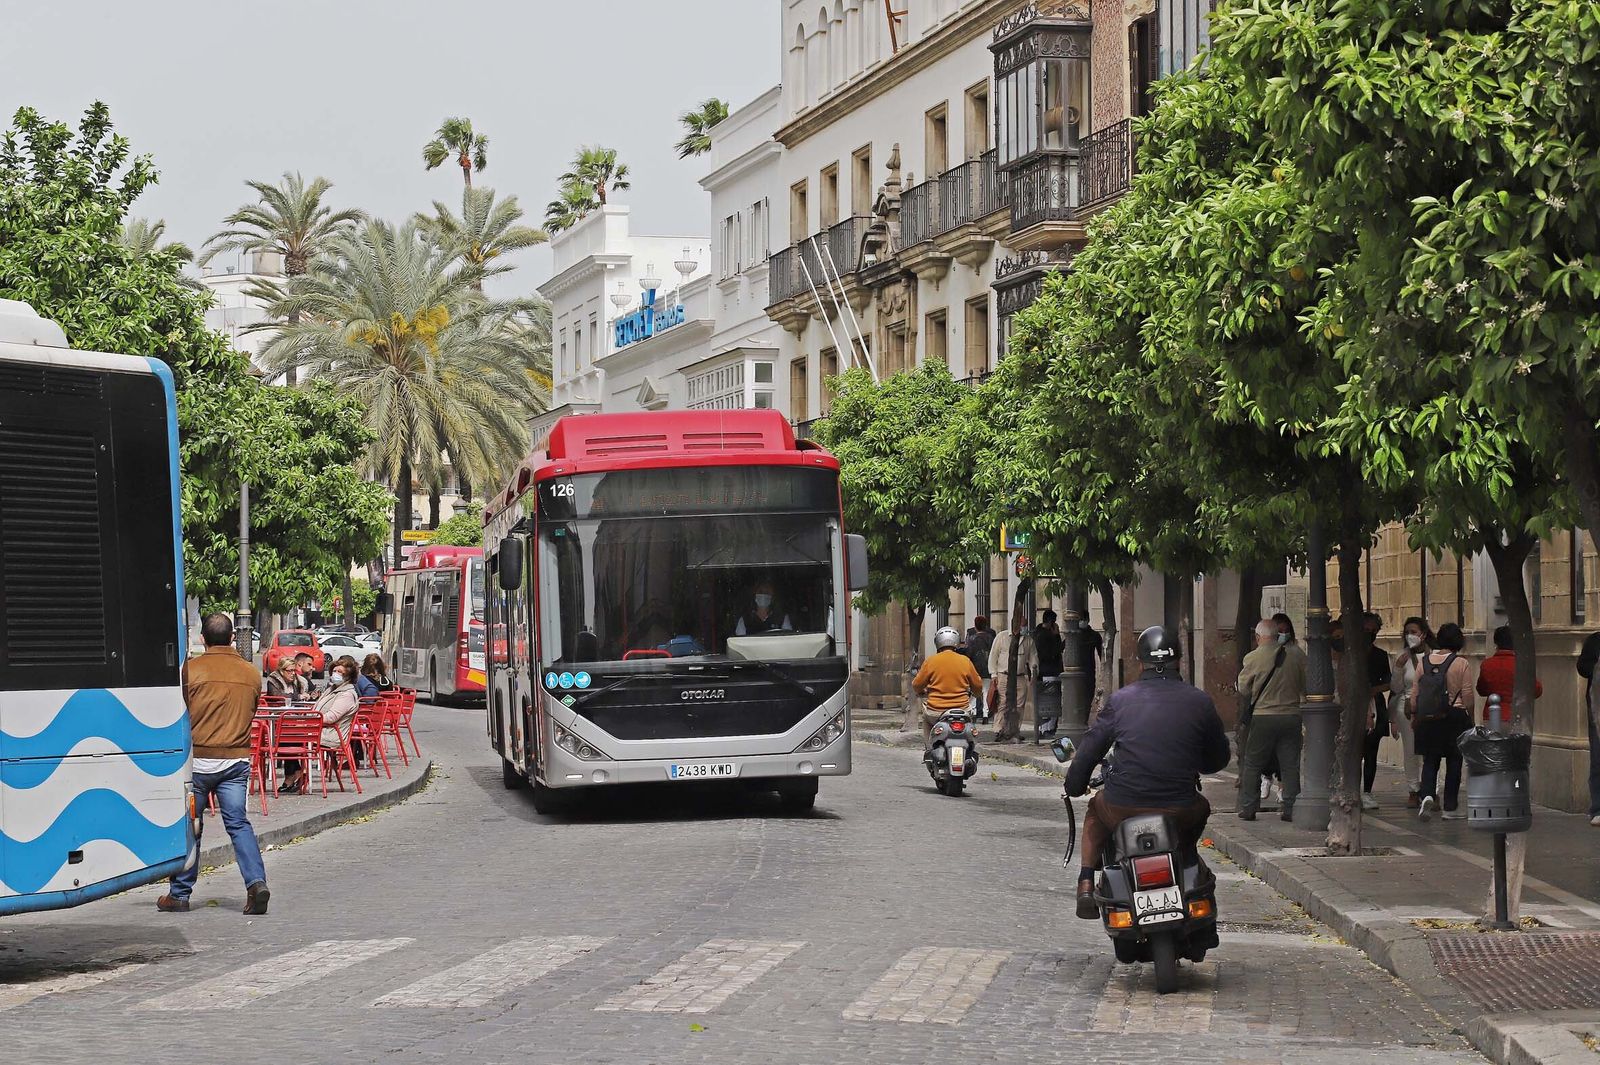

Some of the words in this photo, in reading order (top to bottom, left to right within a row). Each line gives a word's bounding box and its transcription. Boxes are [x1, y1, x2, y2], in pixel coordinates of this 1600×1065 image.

[550, 484, 575, 497] 126
[681, 689, 725, 700] OTOKAR
[678, 765, 707, 777] 2438
[710, 764, 732, 776] KWD
